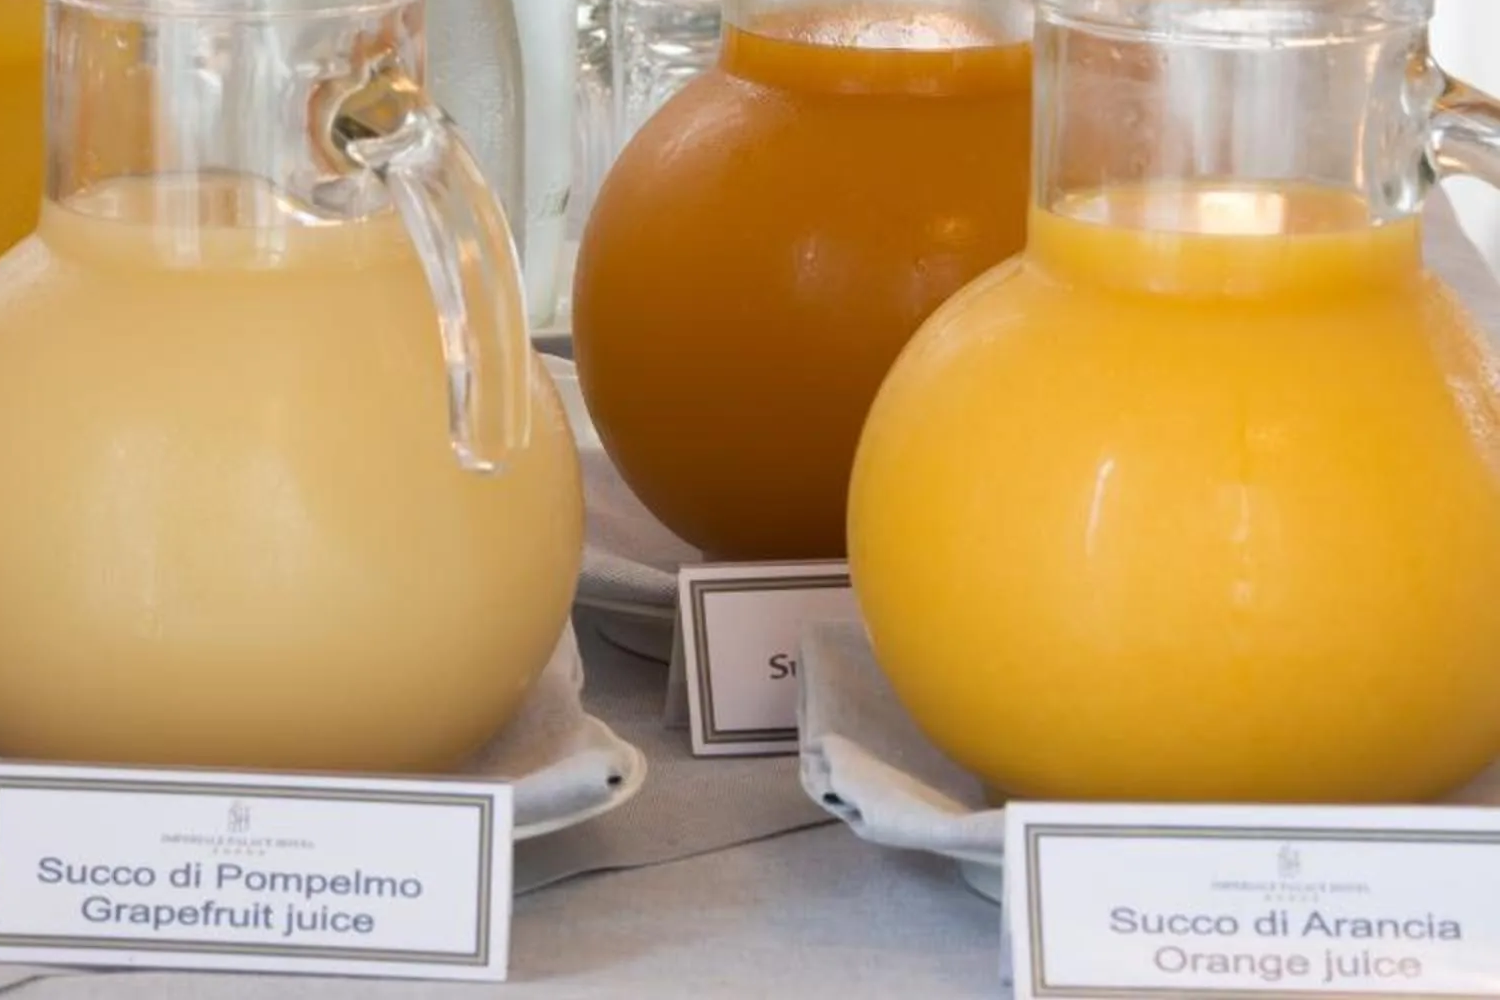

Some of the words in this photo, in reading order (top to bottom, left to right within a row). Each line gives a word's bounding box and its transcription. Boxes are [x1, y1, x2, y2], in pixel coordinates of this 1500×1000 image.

[37, 856, 156, 888] Succo
[169, 861, 202, 889] di
[216, 862, 423, 900] Pompelmo
[80, 895, 274, 930] Grapefruit
[282, 903, 375, 937] juice
[1109, 906, 1240, 937] Succo
[1253, 909, 1289, 937] di
[1301, 909, 1463, 941] Arancia
[1153, 945, 1311, 982] Orange
[1321, 948, 1423, 983] juice
